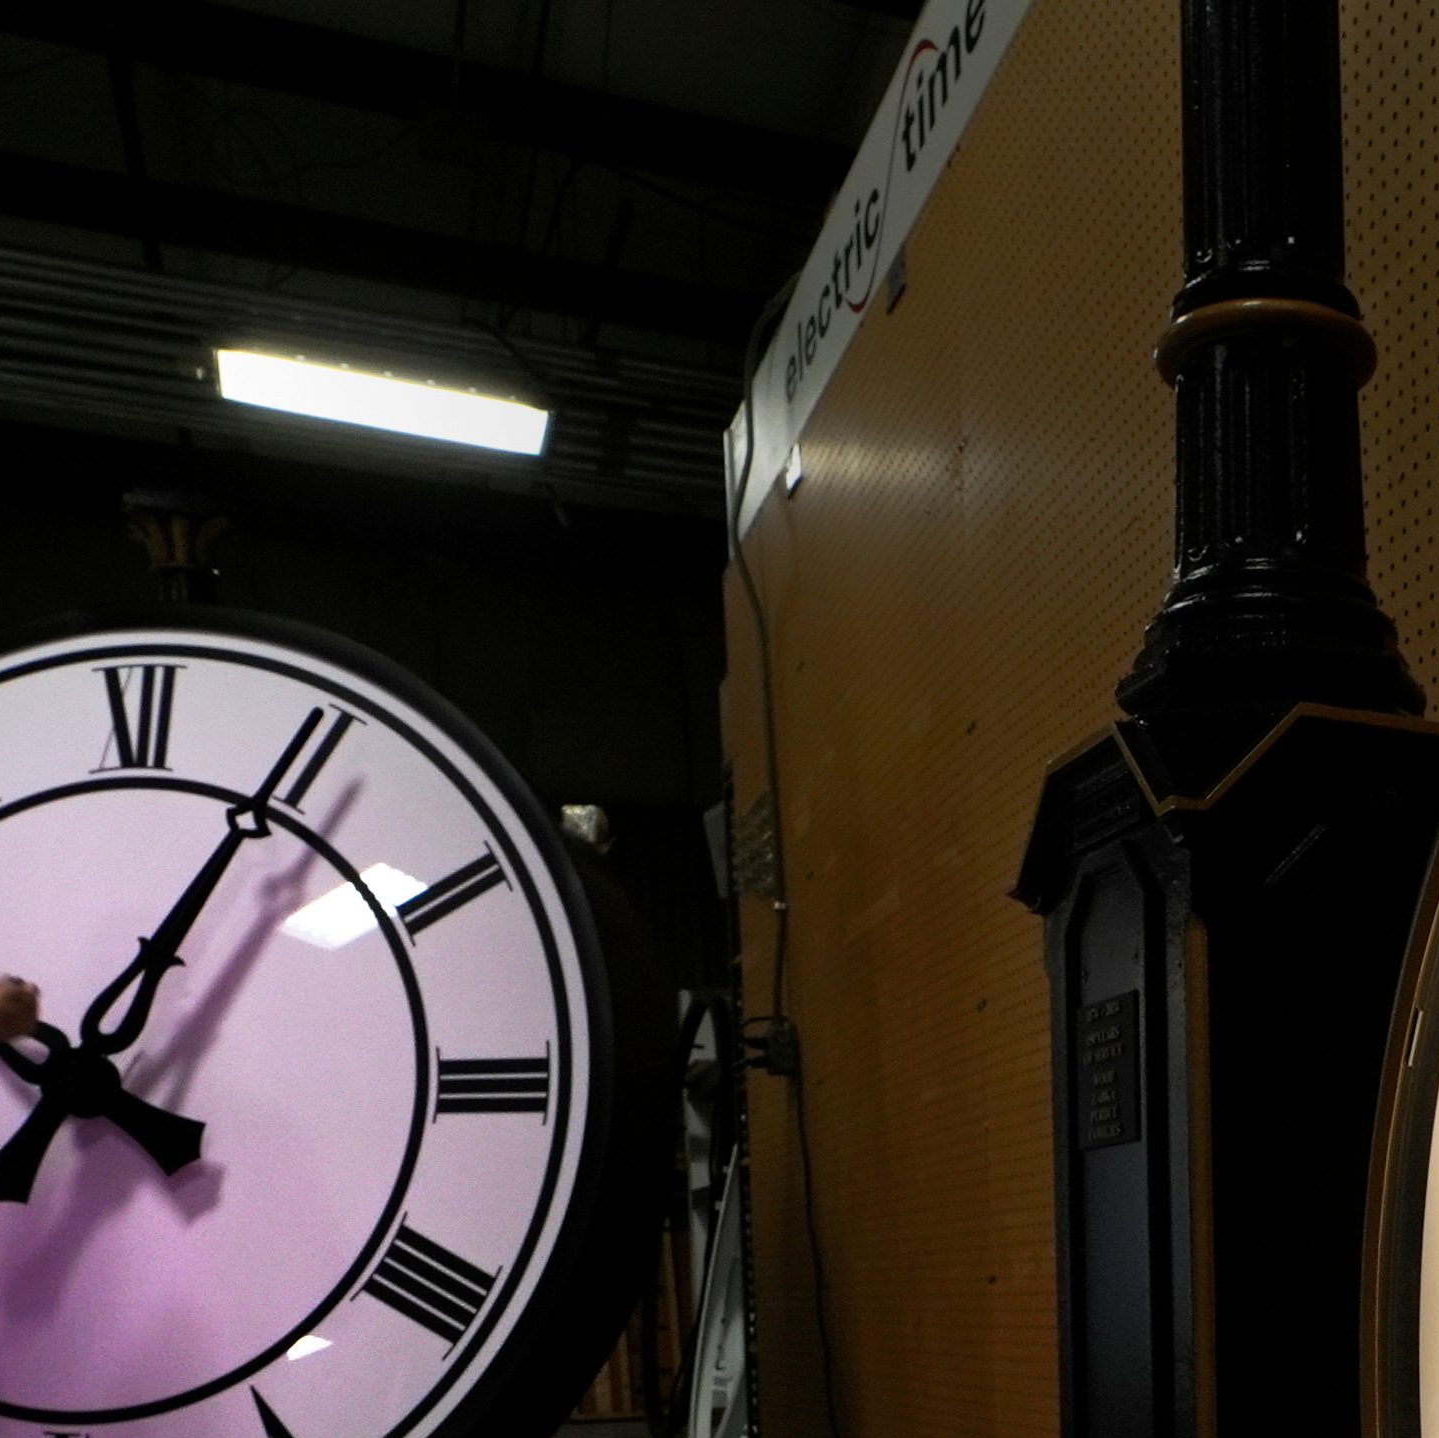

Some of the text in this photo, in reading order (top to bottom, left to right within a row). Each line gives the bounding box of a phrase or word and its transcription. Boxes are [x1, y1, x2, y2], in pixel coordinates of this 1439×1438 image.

[785, 0, 987, 403] electric time
[90, 664, 187, 773] XII
[394, 840, 513, 947] II
[433, 1040, 551, 1126] III
[350, 1211, 503, 1361] IIII
